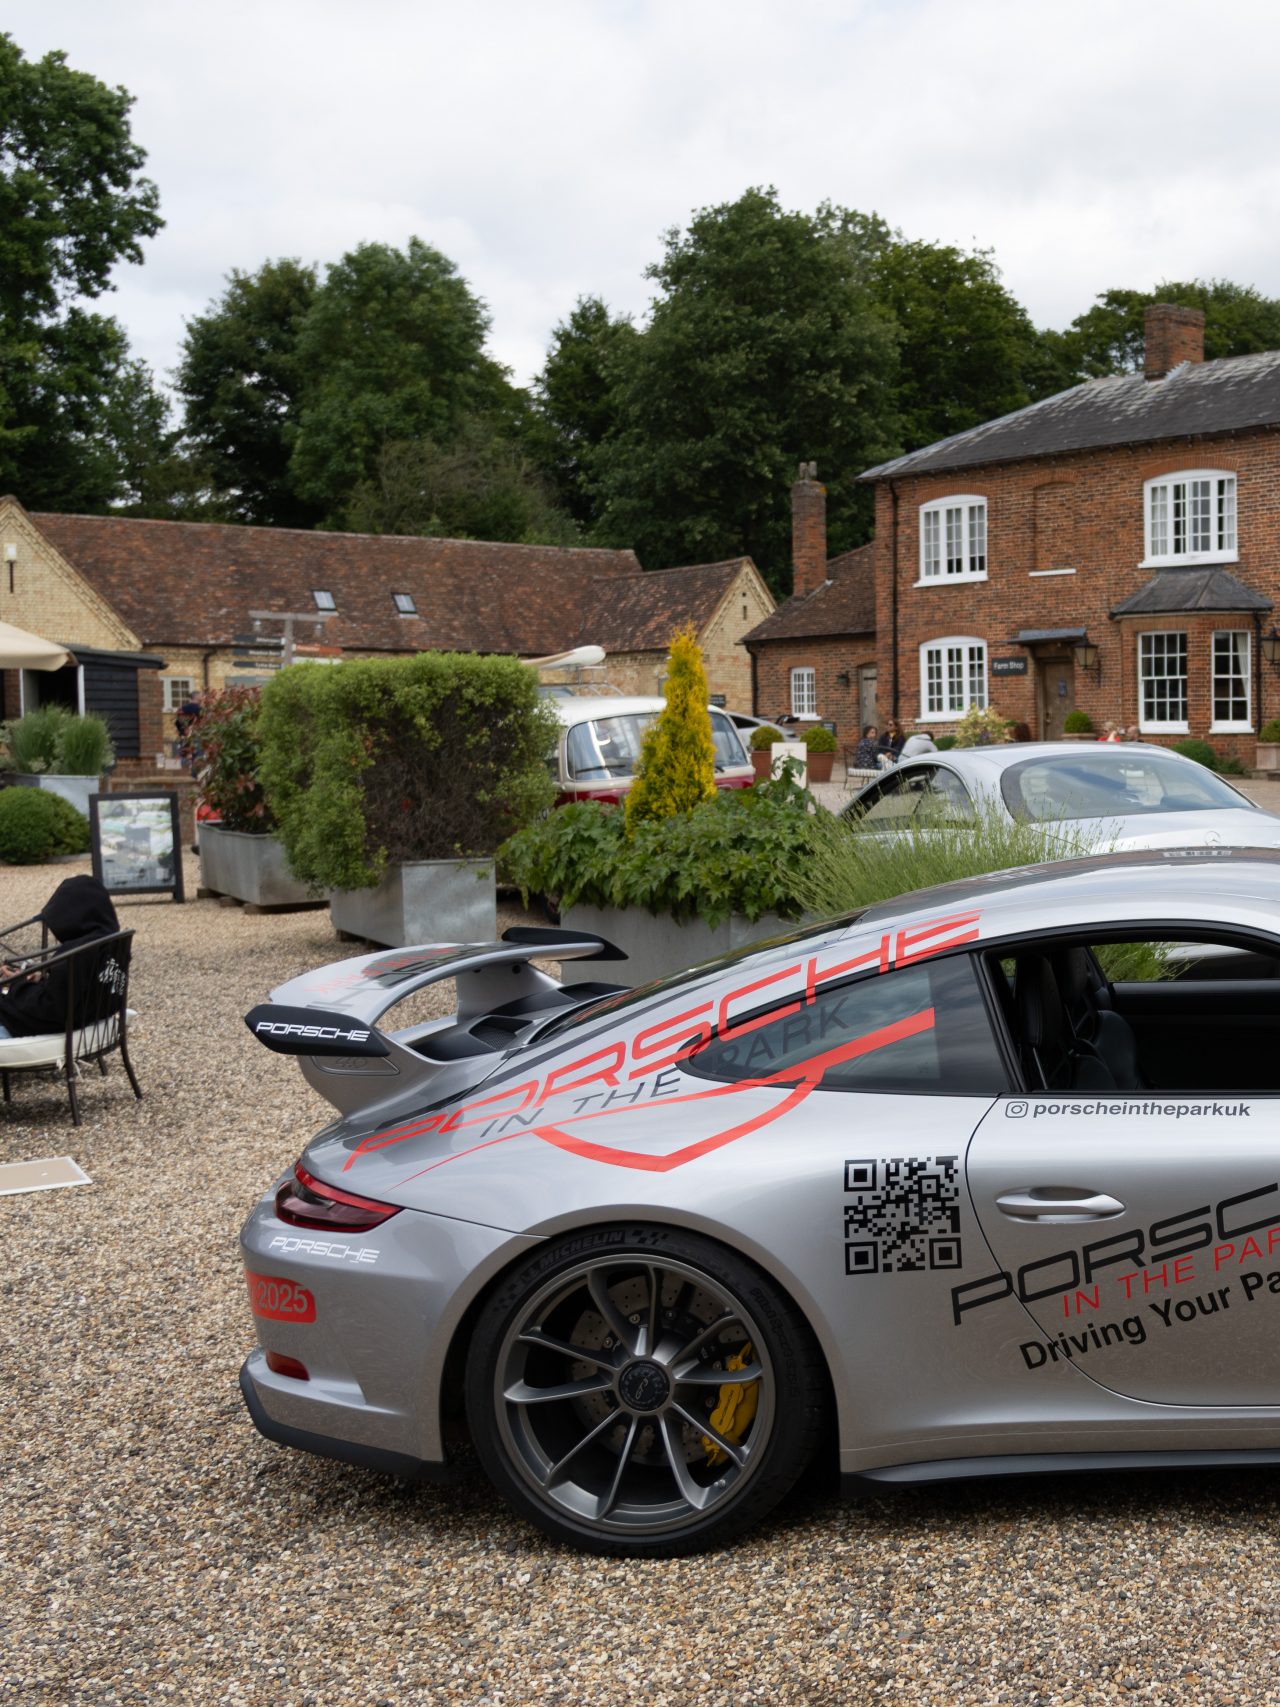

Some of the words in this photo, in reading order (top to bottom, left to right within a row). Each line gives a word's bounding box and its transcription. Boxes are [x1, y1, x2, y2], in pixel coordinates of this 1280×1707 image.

[993, 662, 1008, 670] Farm
[1010, 660, 1024, 670] Shop
[256, 1021, 371, 1042] PORSCHE
[342, 908, 985, 1173] PORSCHE
[480, 1107, 544, 1139] IN
[573, 1067, 681, 1114] THE
[710, 997, 850, 1071] PARK
[1033, 1101, 1251, 1119] porscheintheparkuk
[268, 1236, 380, 1263] PORSCHE
[540, 1230, 623, 1269] MICHELIN
[256, 1281, 308, 1314] 2025
[1062, 1285, 1102, 1318] IN
[1117, 1255, 1197, 1300] THE
[1019, 1314, 1148, 1370] Driving
[1148, 1286, 1233, 1328] Your
